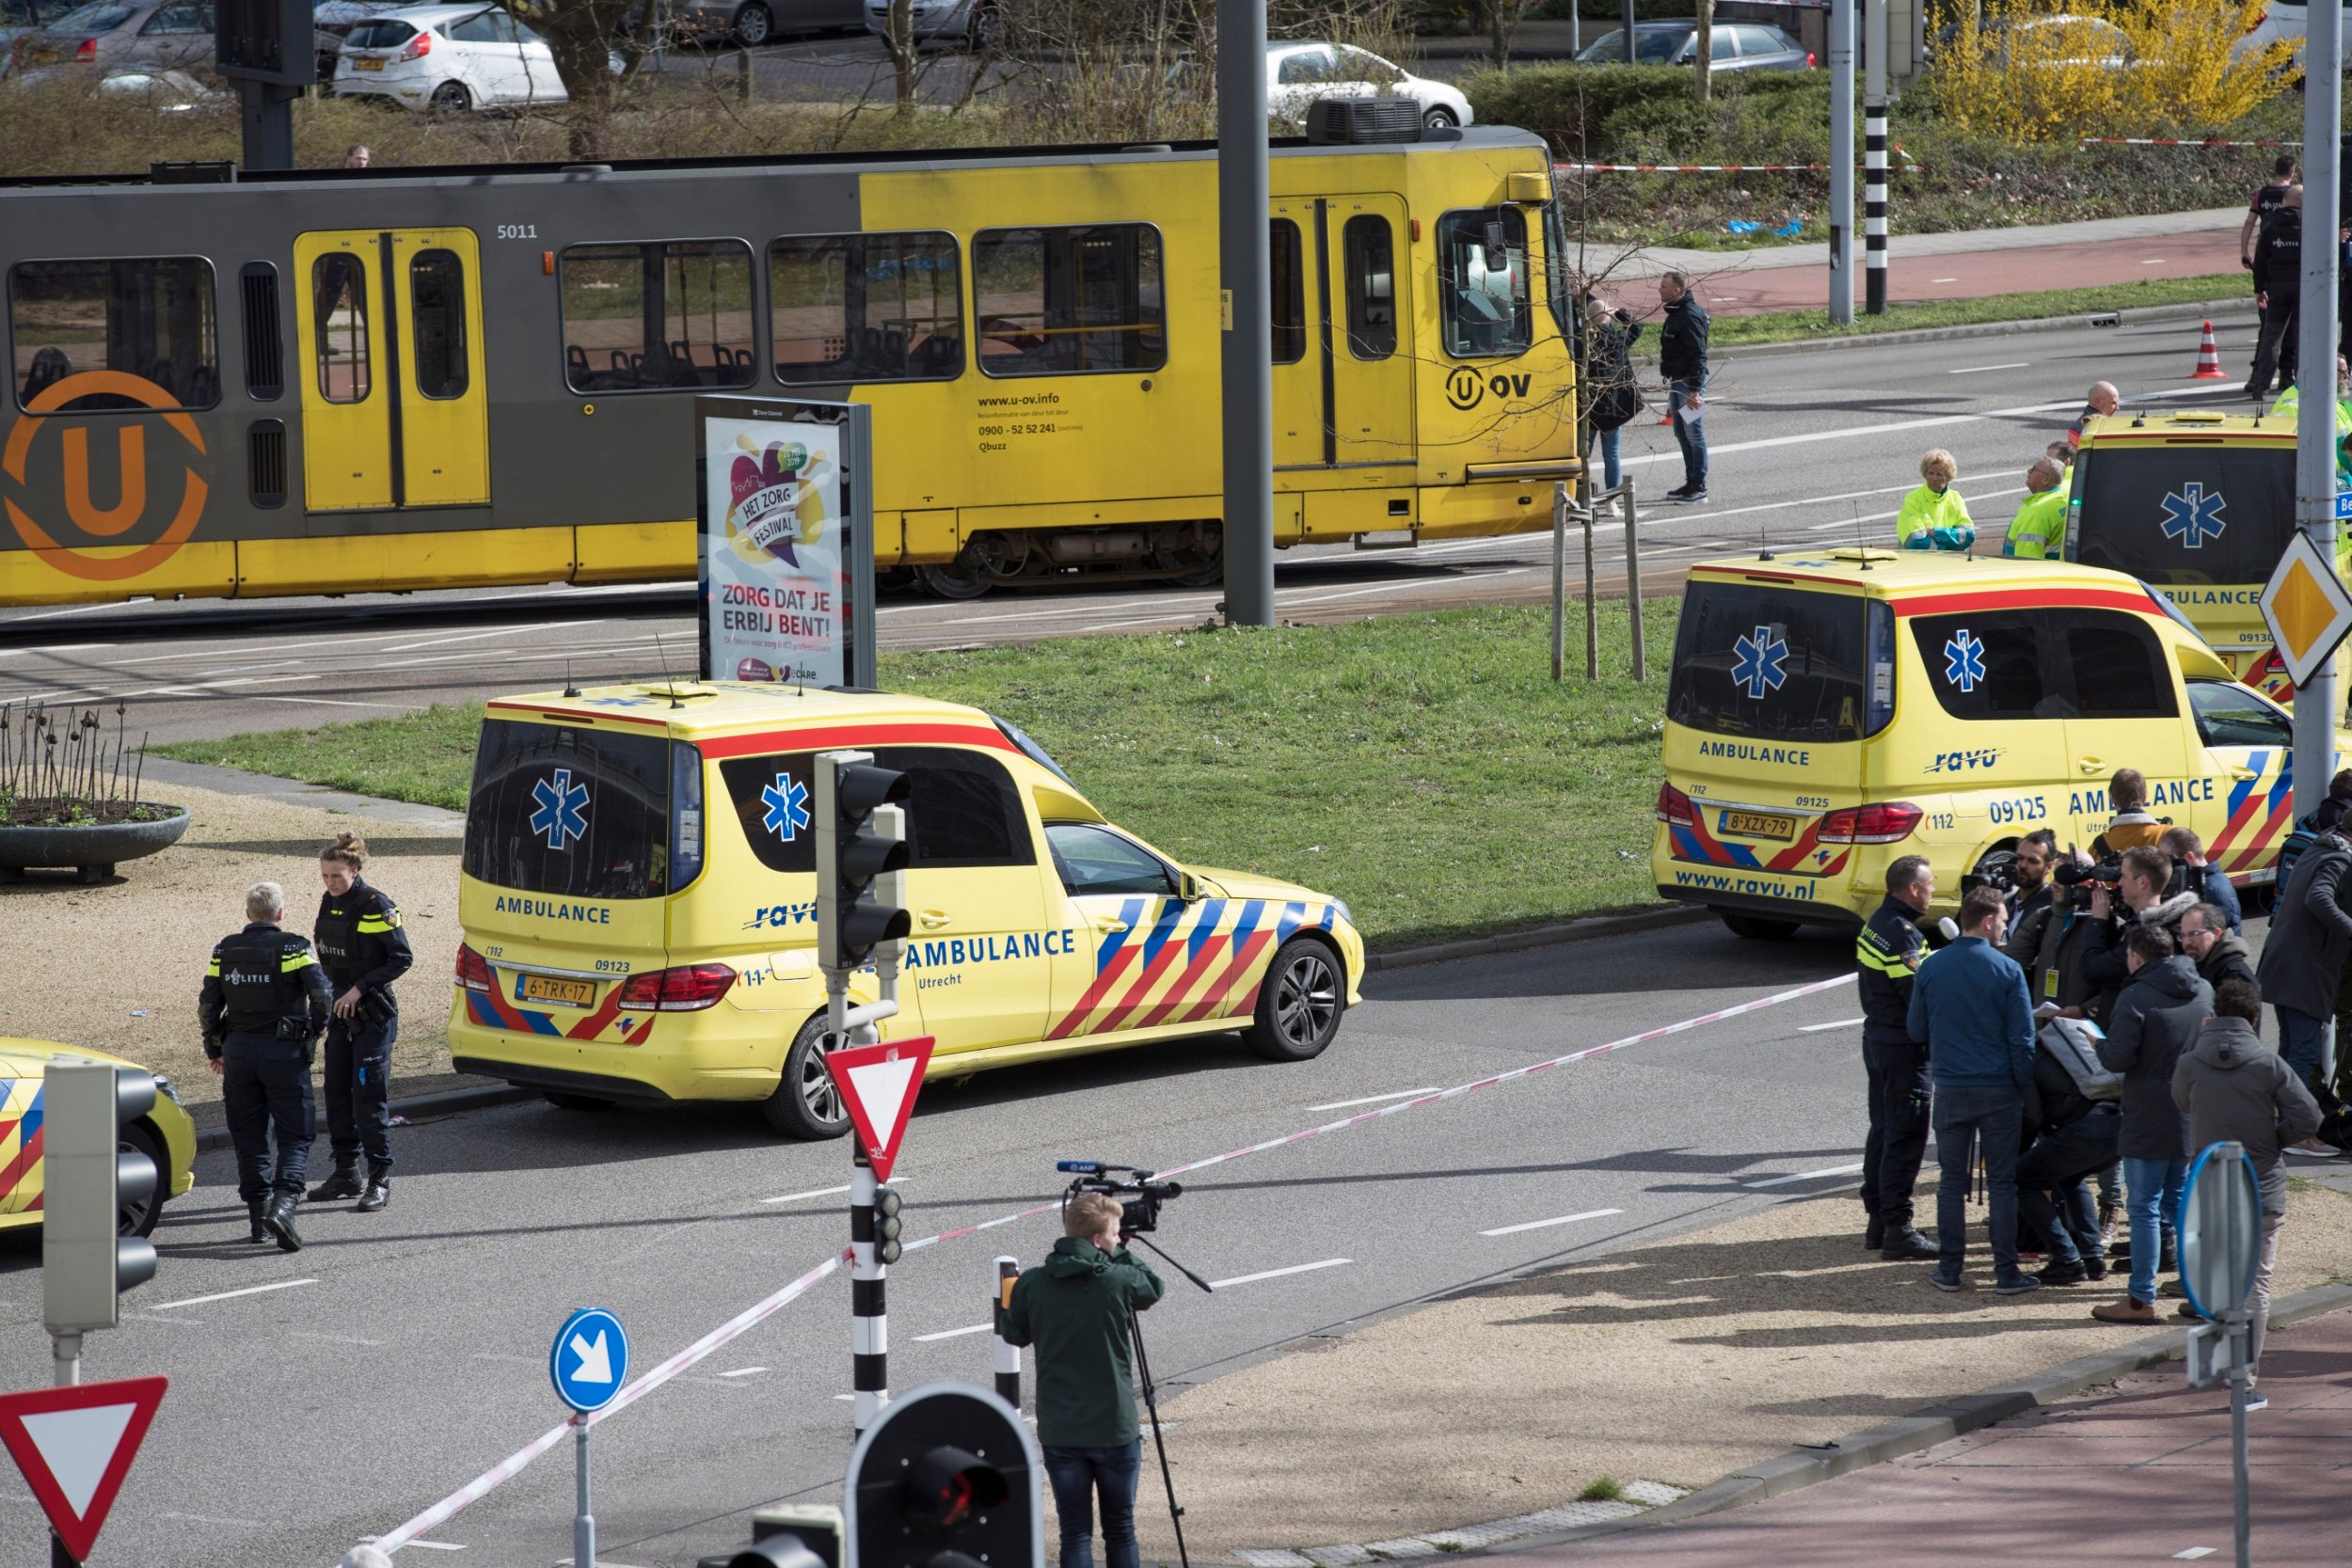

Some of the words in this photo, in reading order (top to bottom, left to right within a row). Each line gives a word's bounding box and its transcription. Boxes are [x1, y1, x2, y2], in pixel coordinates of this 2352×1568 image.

[498, 225, 537, 239] 5011
[978, 392, 1059, 406] www.u-ov.info
[978, 426, 1003, 436] 0900
[1011, 425, 1023, 434] 52
[1026, 424, 1037, 434] 52
[1040, 423, 1056, 433] 241
[978, 442, 1007, 452] Qbuzz
[742, 498, 759, 519] HET
[763, 488, 791, 508] ZORG
[754, 516, 793, 546] FESTIVAL
[723, 584, 770, 608] ZORG
[775, 589, 805, 610] DAT
[811, 592, 830, 612] JE
[2164, 592, 2259, 605] BULANCE
[723, 610, 772, 633] ERBIJ
[779, 613, 830, 639] BENT!
[764, 641, 776, 649] zorg
[2239, 633, 2274, 642] 09130
[1699, 741, 1809, 766] AMBULANCE
[1930, 749, 2000, 772] ravu
[1796, 797, 1829, 807] 09125
[1990, 796, 2046, 824] 09125
[1730, 815, 1788, 834] 8-XZX-79
[2087, 822, 2109, 832] Utre
[1676, 871, 1816, 900] www.ravu.nl
[495, 895, 610, 924] AMBULANCE
[905, 929, 1074, 970] AMBULANCE
[596, 959, 630, 973] 09123
[225, 969, 270, 985] POLITIE
[919, 974, 961, 989] Utrecht
[530, 979, 587, 1000] 6-TRK-17
